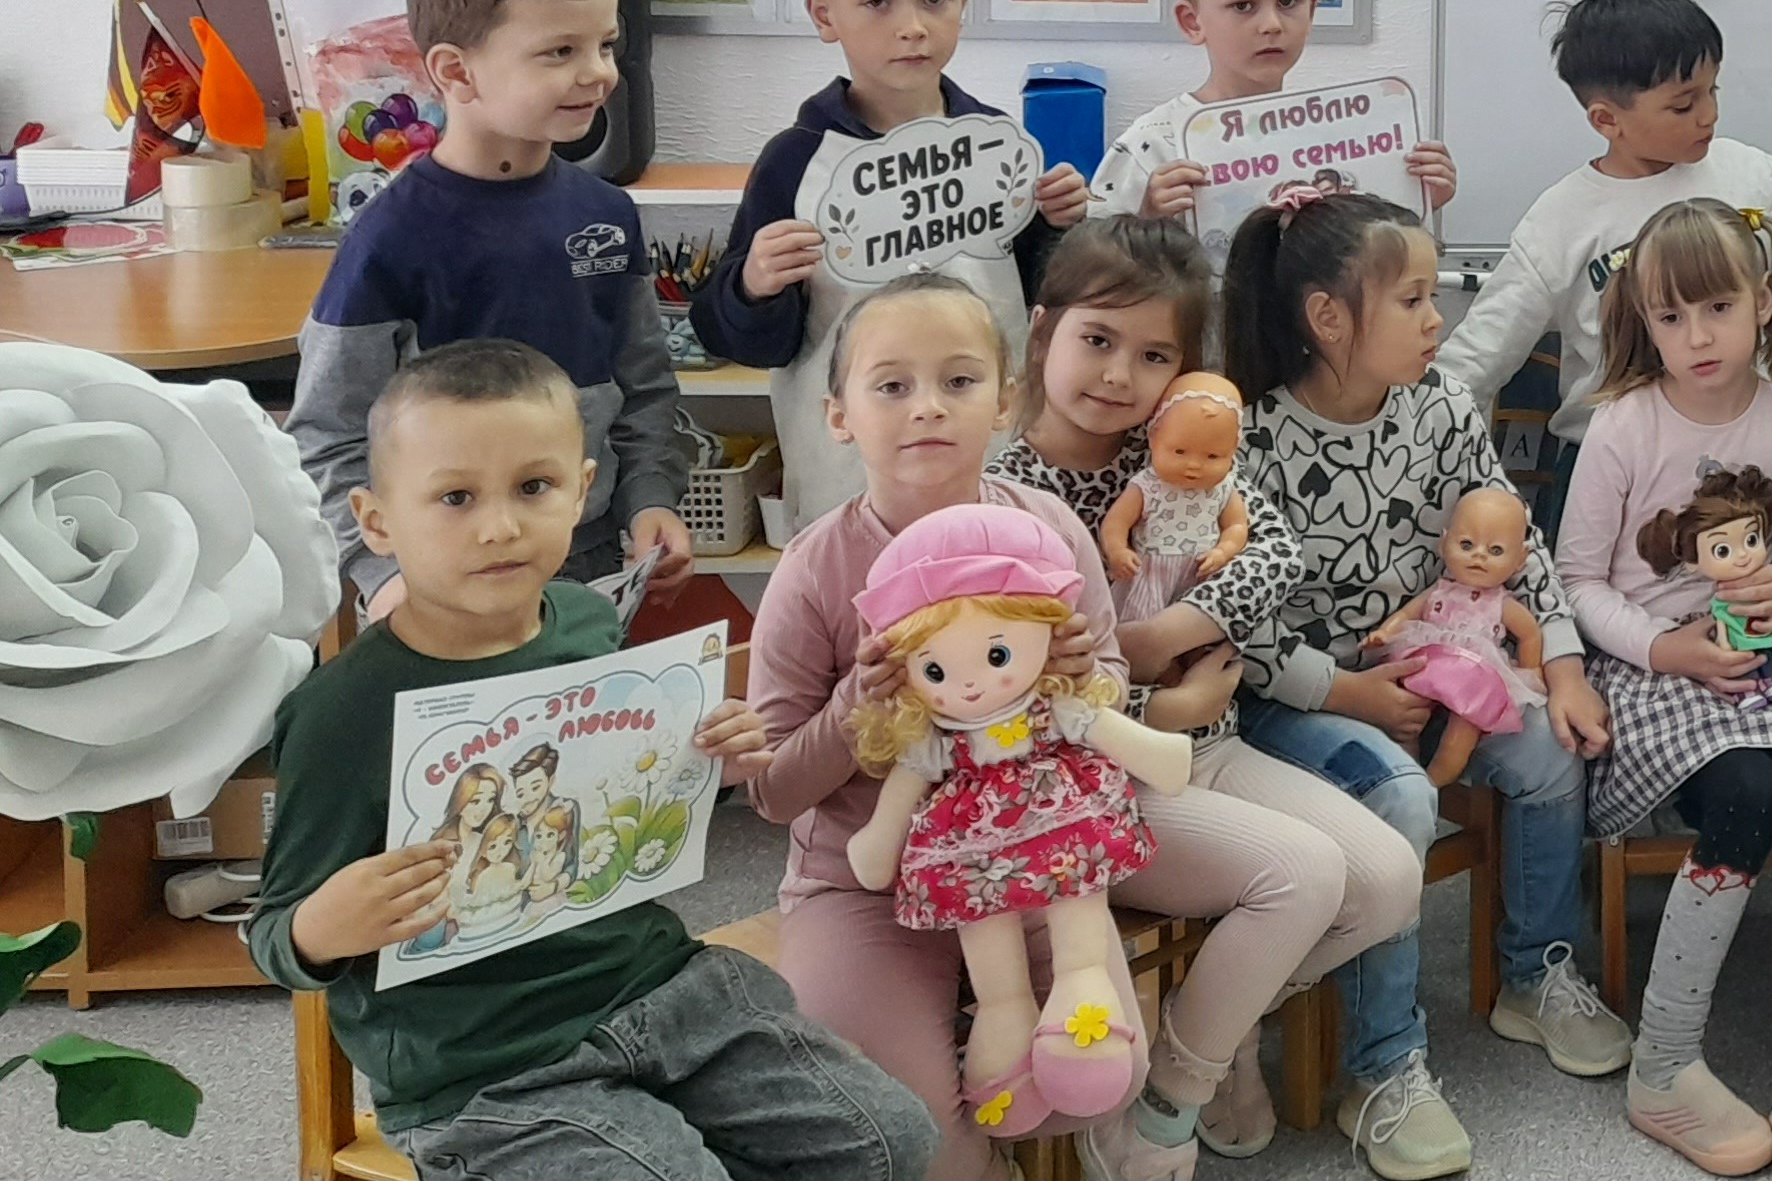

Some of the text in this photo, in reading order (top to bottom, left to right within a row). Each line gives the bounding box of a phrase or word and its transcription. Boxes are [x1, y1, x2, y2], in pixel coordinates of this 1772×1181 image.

[1219, 94, 1371, 143] Я люблю
[853, 135, 972, 196] СЕМЬЯ
[1204, 123, 1404, 187] вою семью!
[900, 178, 964, 221] ЭТО
[866, 201, 1004, 267] ГЛАВНОЕ
[424, 716, 520, 786] СЕМЬЯ
[545, 686, 597, 720] ЭТО
[558, 708, 656, 744] ЛЮБОВЬ
